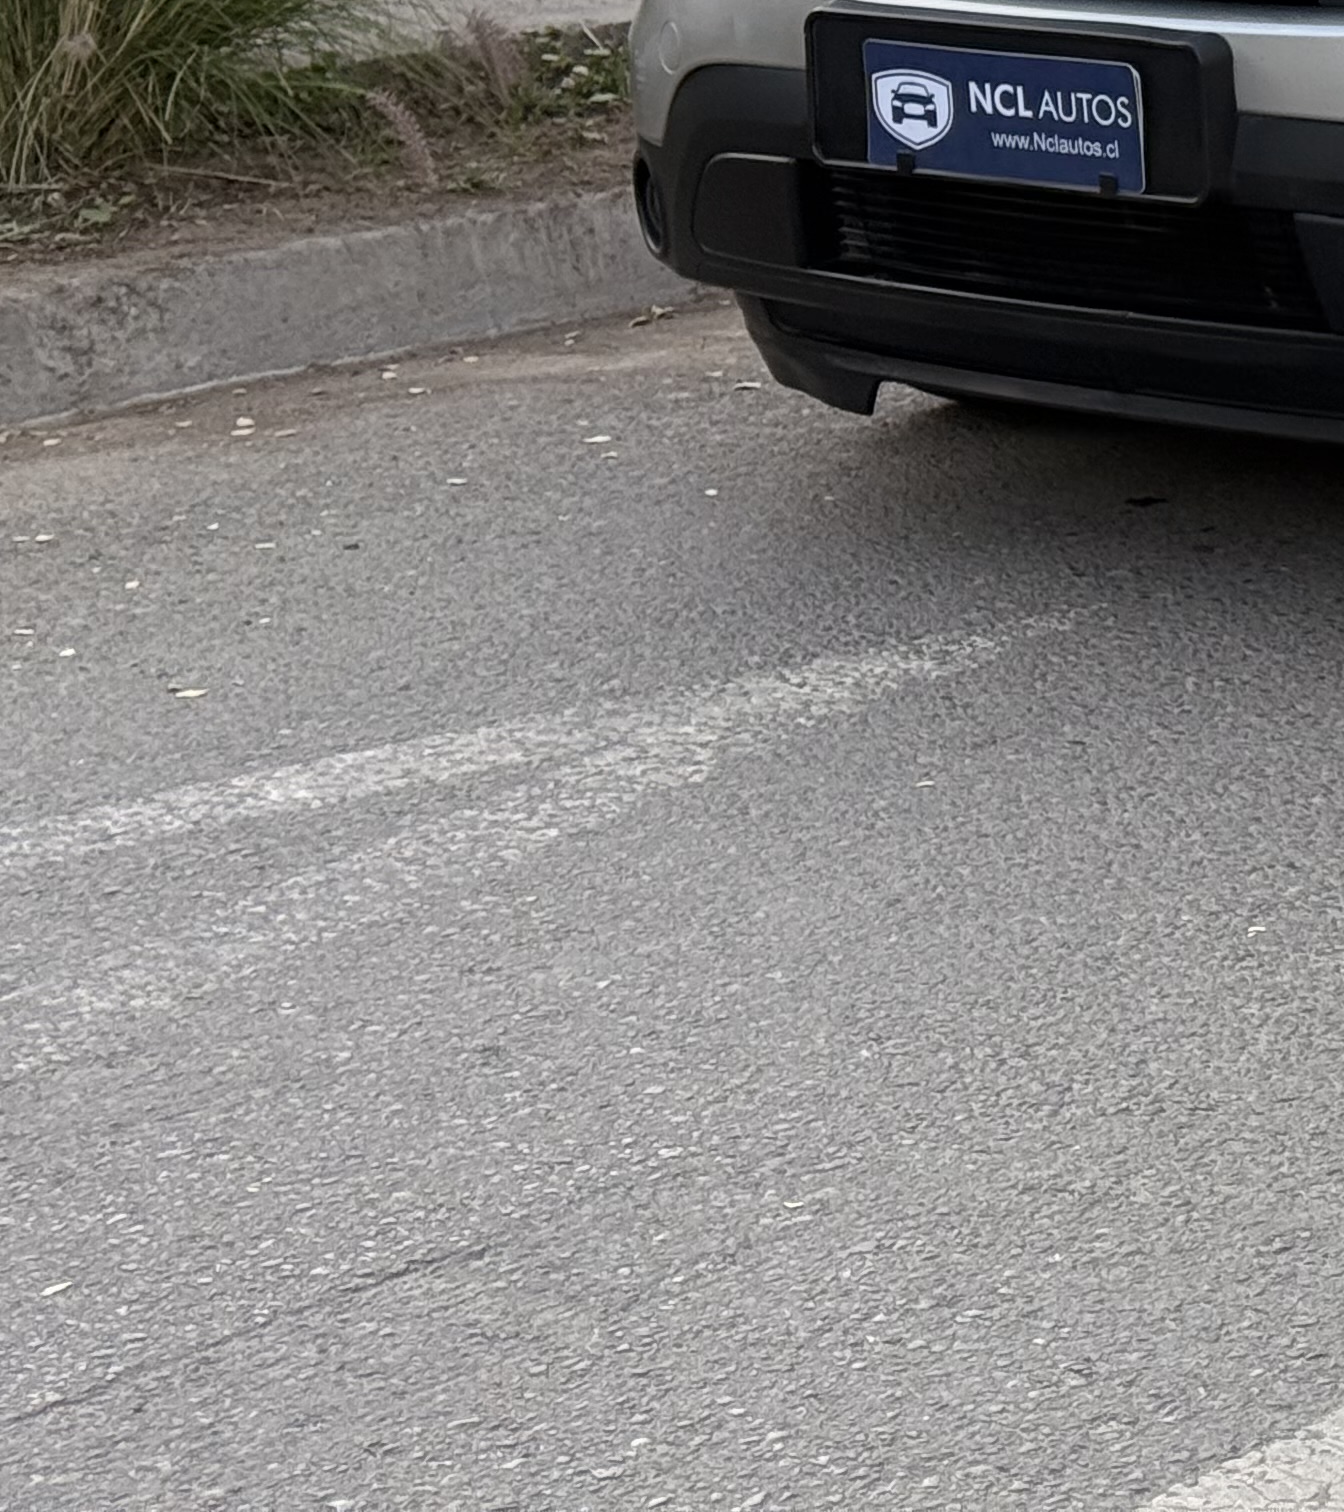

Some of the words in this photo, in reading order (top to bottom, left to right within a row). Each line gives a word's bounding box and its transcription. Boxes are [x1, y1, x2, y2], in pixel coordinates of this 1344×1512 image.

[968, 81, 1033, 118] NCL
[1038, 89, 1132, 128] AUTOS
[991, 131, 1120, 159] www.Nclautos.cl
